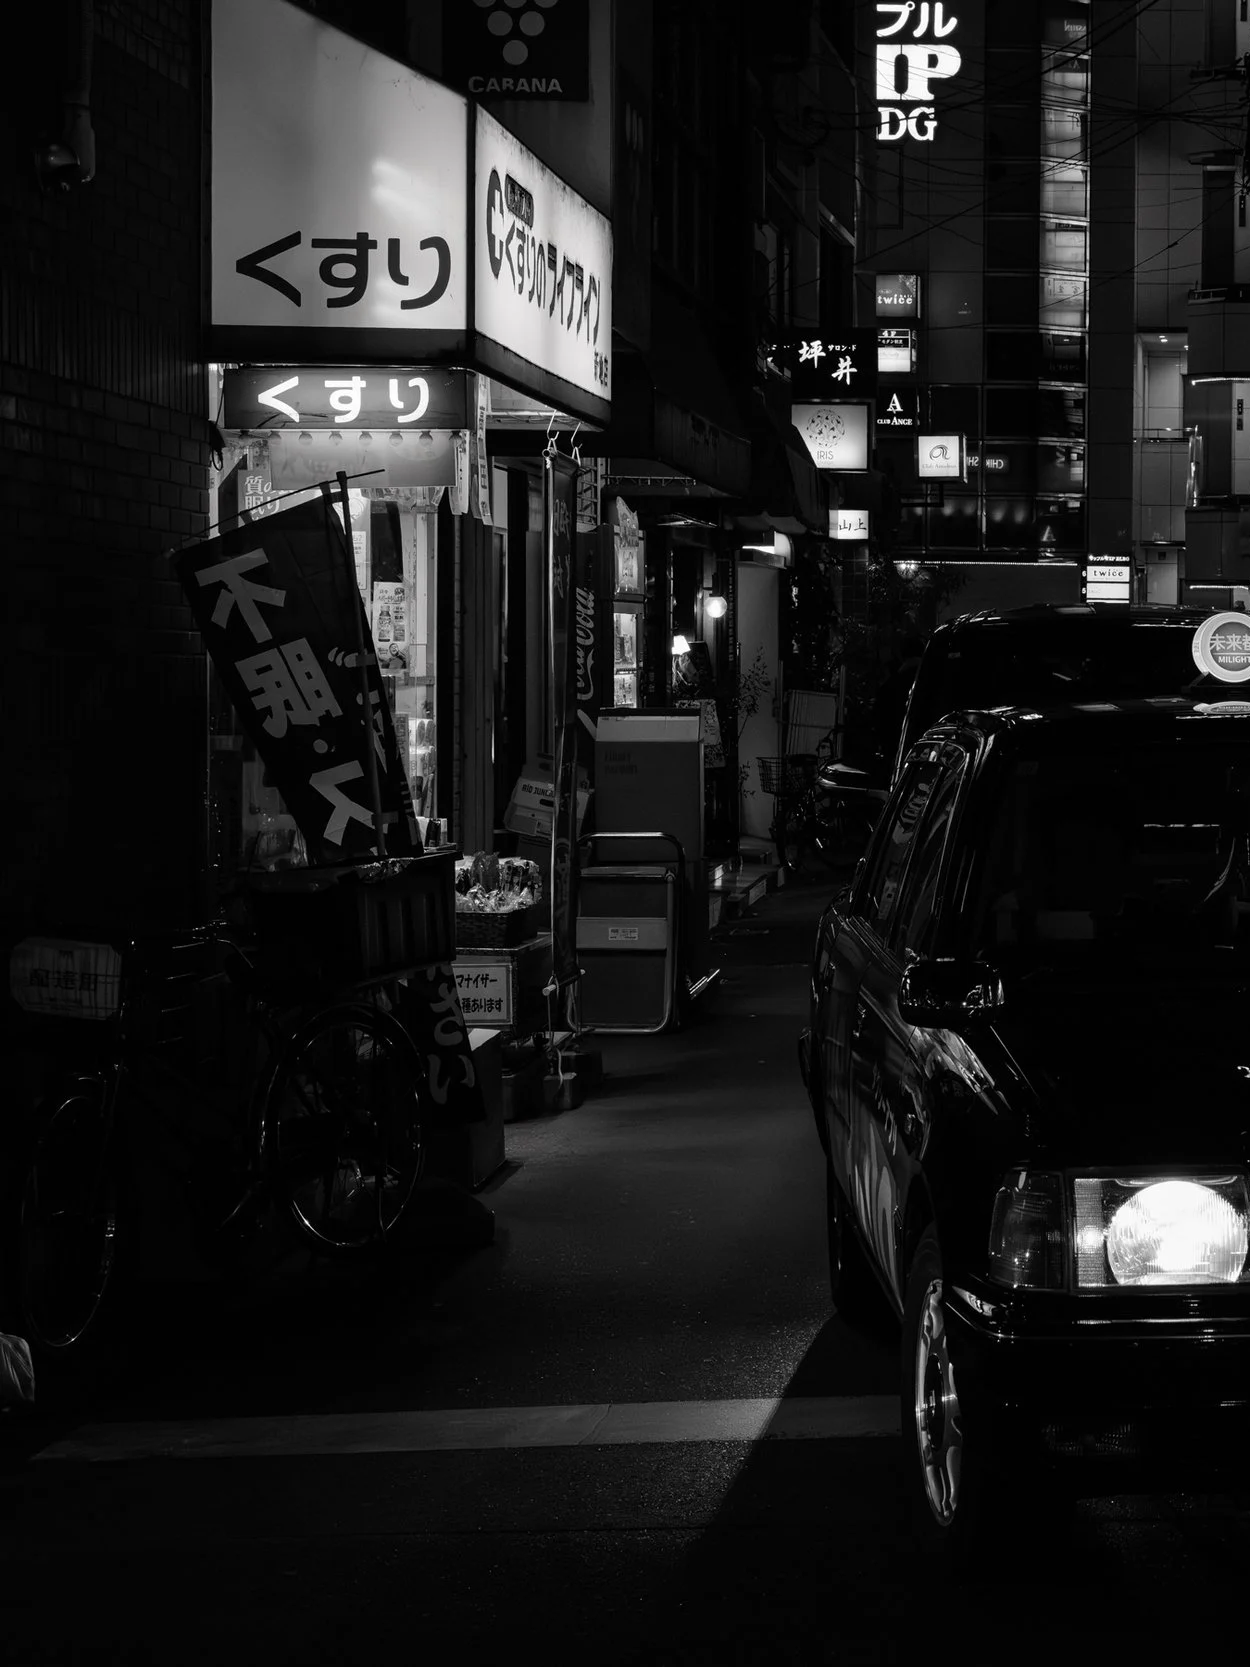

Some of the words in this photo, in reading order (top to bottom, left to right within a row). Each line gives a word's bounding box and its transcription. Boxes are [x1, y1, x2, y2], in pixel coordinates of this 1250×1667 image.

[876, 1, 958, 37] プル
[467, 76, 563, 94] CARANA
[236, 231, 451, 310] くすり
[506, 219, 601, 346] くすりのライフライン
[877, 294, 912, 304] twice
[258, 376, 429, 423] くすり
[817, 450, 834, 461] IRIS
[1093, 569, 1124, 577] twice
